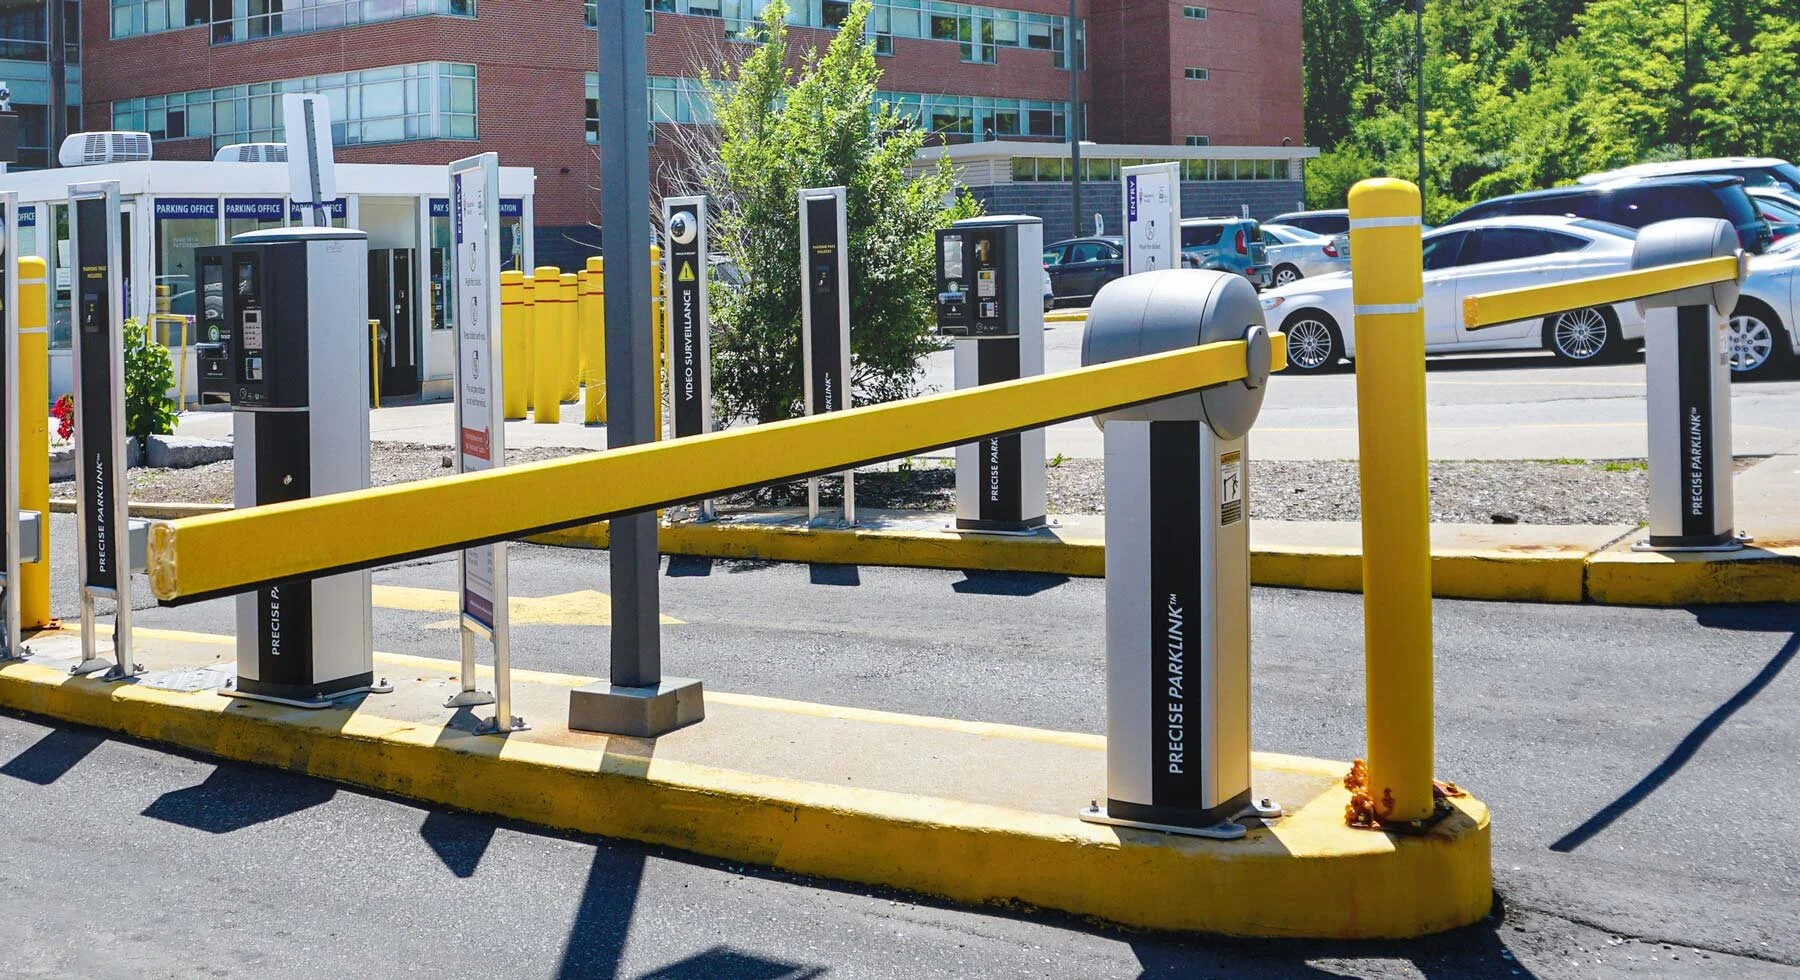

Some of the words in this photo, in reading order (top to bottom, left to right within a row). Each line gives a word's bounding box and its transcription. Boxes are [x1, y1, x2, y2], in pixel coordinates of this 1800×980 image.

[156, 204, 189, 214] PARKING
[190, 203, 215, 214] OFFICE
[226, 204, 256, 213] PARKING
[257, 203, 281, 213] OFFICE
[433, 204, 444, 212] PAY
[683, 289, 693, 366] SURVEILLANCE
[685, 367, 694, 401] VIDEO
[991, 465, 999, 501] PRECISE
[1691, 472, 1703, 515] PRECISE
[97, 525, 106, 573] PRECISE
[270, 602, 281, 656] PRECISE
[1168, 593, 1184, 699] PARKLINK™
[1168, 703, 1184, 774] PRECISE
